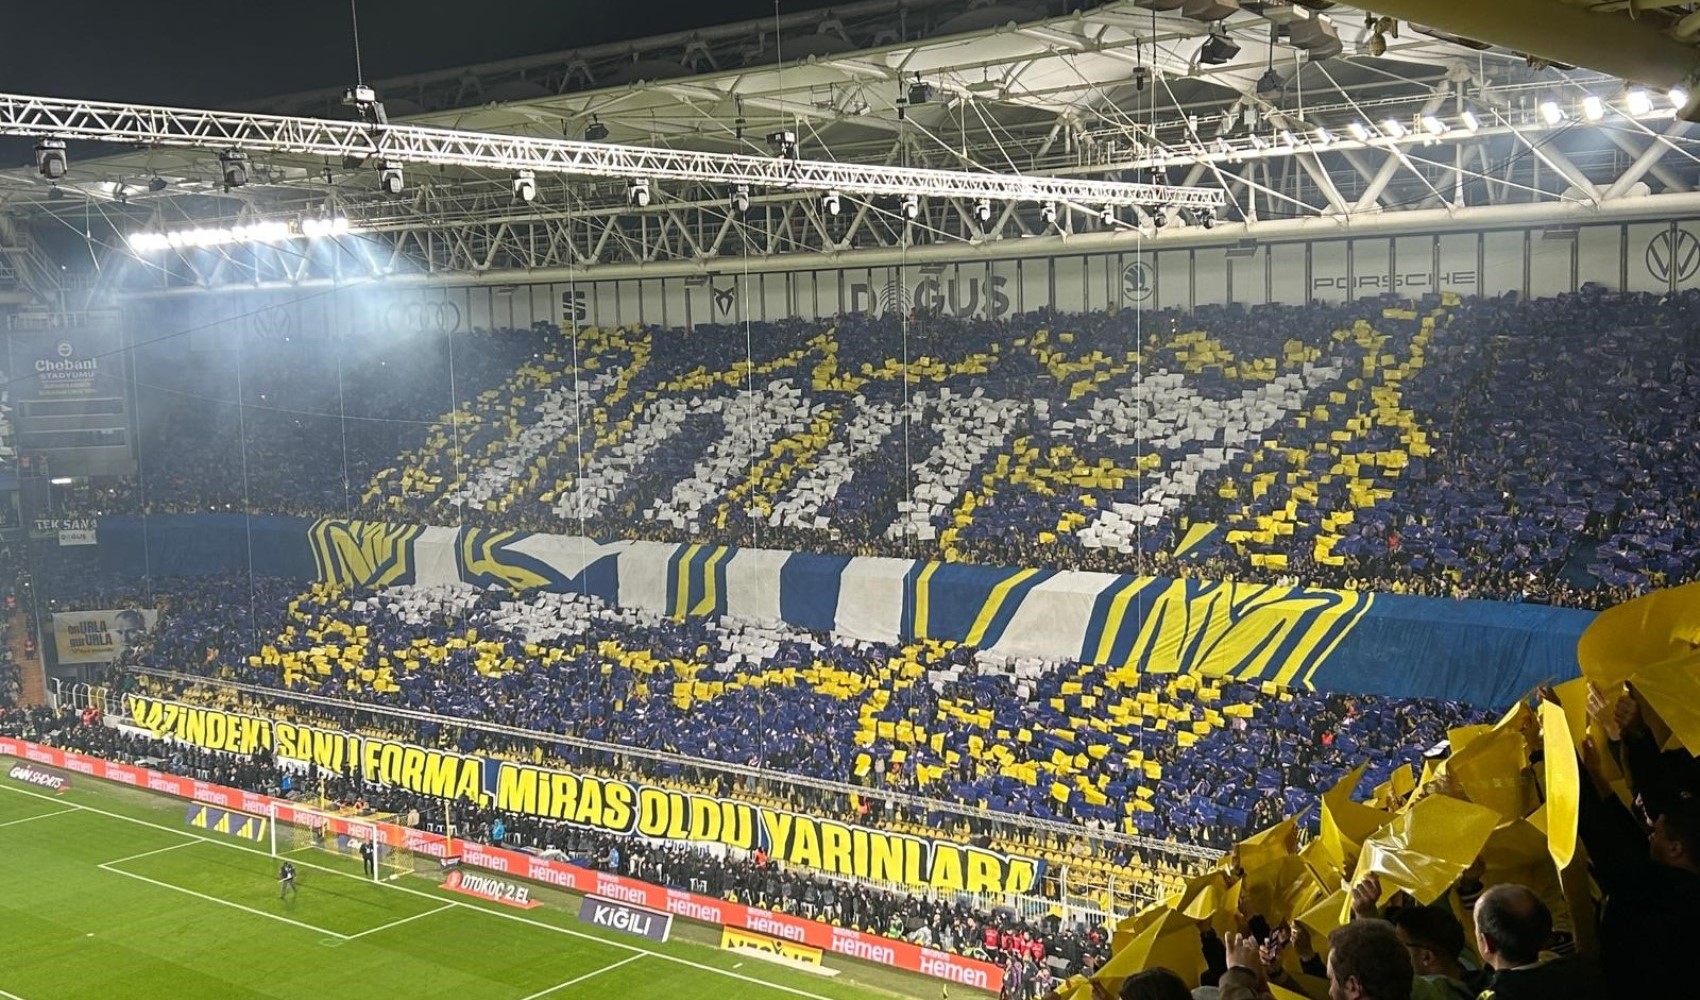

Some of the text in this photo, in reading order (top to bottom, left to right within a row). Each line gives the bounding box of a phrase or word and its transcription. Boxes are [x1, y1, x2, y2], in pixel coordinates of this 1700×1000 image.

[1314, 272, 1475, 289] PORSCHE
[35, 358, 96, 371] Chobani
[35, 519, 58, 530] TEK
[31, 771, 64, 788] SHORTS
[194, 786, 228, 806] Hemen
[405, 837, 446, 859] Hemen
[638, 789, 752, 849] OLDU
[760, 810, 1034, 893] YARINLARA
[464, 849, 508, 872] Hemen
[461, 874, 504, 899] OTOKOÇ
[529, 864, 575, 887] Hemen
[597, 880, 647, 904] Hemen
[666, 897, 720, 923] Hemen
[747, 916, 805, 942] Hemen
[831, 934, 895, 965] Hemen
[919, 955, 987, 988] Hemen
